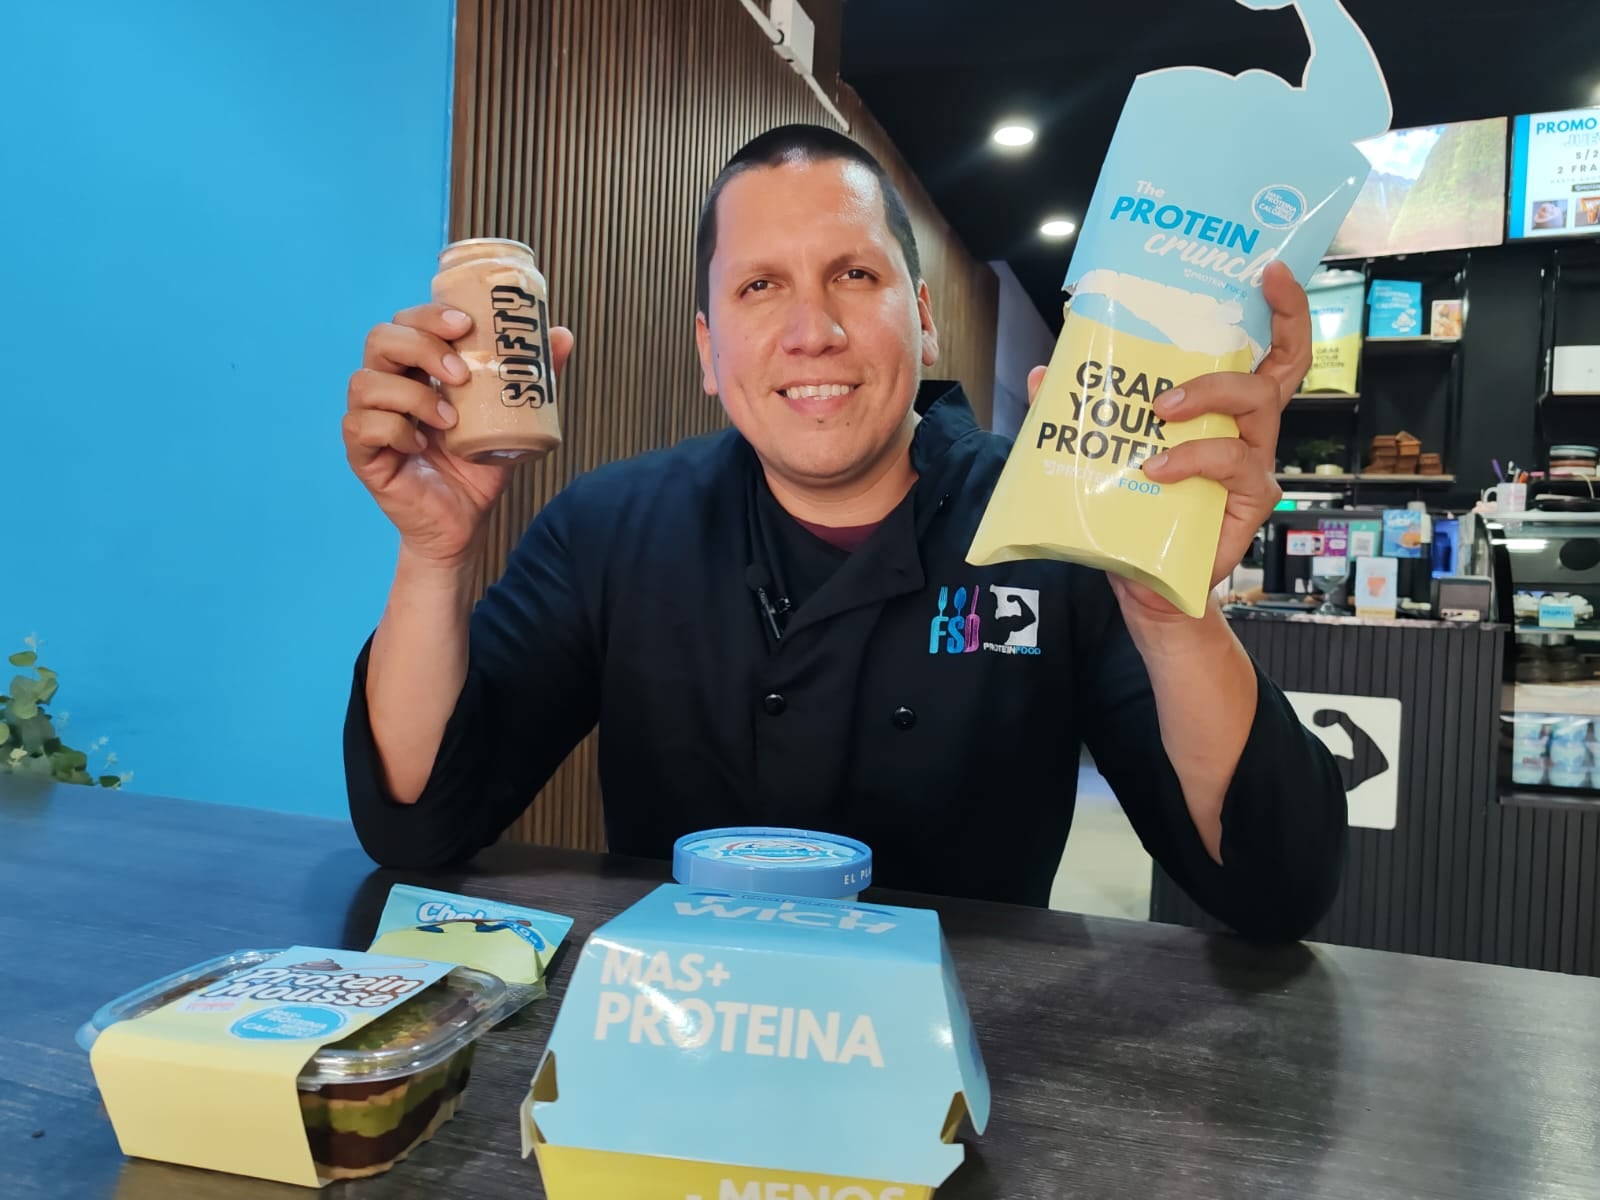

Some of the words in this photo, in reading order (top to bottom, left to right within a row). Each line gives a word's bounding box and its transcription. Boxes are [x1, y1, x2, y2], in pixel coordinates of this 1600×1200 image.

[1536, 117, 1598, 135] PROMO
[1136, 180, 1166, 198] The
[1110, 196, 1260, 254] PROTEIN
[1143, 233, 1279, 288] crunch
[490, 285, 546, 409] SOFTY
[1069, 391, 1167, 441] YOUR
[1036, 421, 1169, 471] PROTE
[844, 874, 856, 884] EL
[231, 967, 425, 995] Protein
[600, 948, 731, 993] MAS+
[204, 981, 402, 1009] Mousse
[593, 991, 885, 1069] PROTEINA
